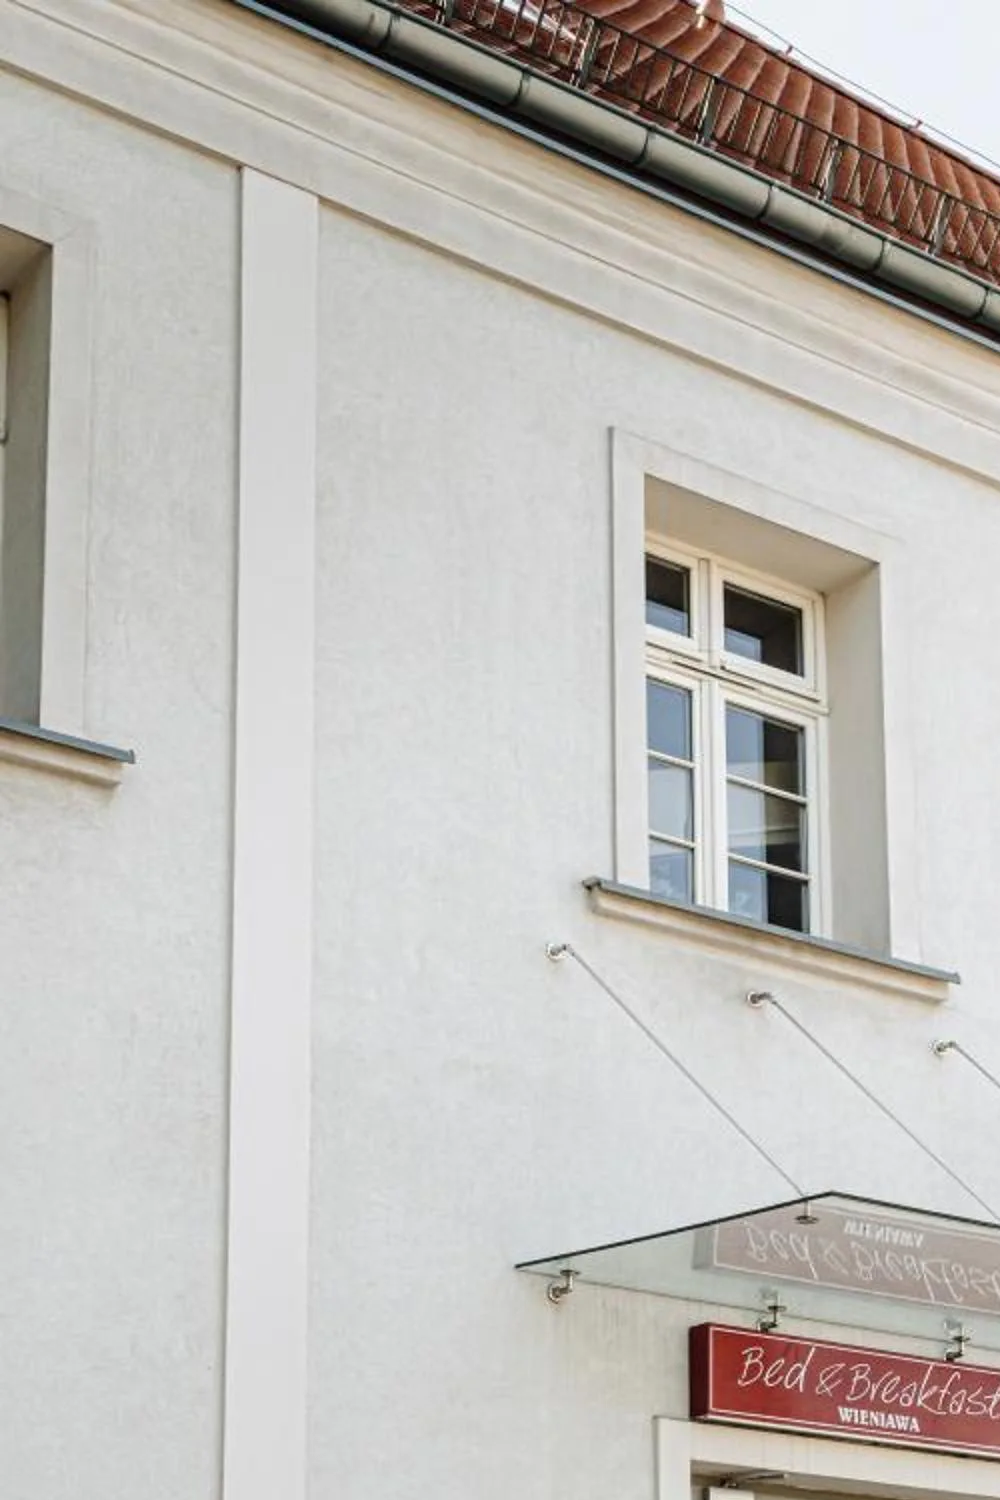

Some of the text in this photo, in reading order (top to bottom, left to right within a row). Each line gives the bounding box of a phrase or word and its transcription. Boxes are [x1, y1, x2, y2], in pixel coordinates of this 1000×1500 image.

[737, 1346, 815, 1393] Bed
[815, 1363, 841, 1397] &
[837, 1406, 921, 1433] WIENIAWA
